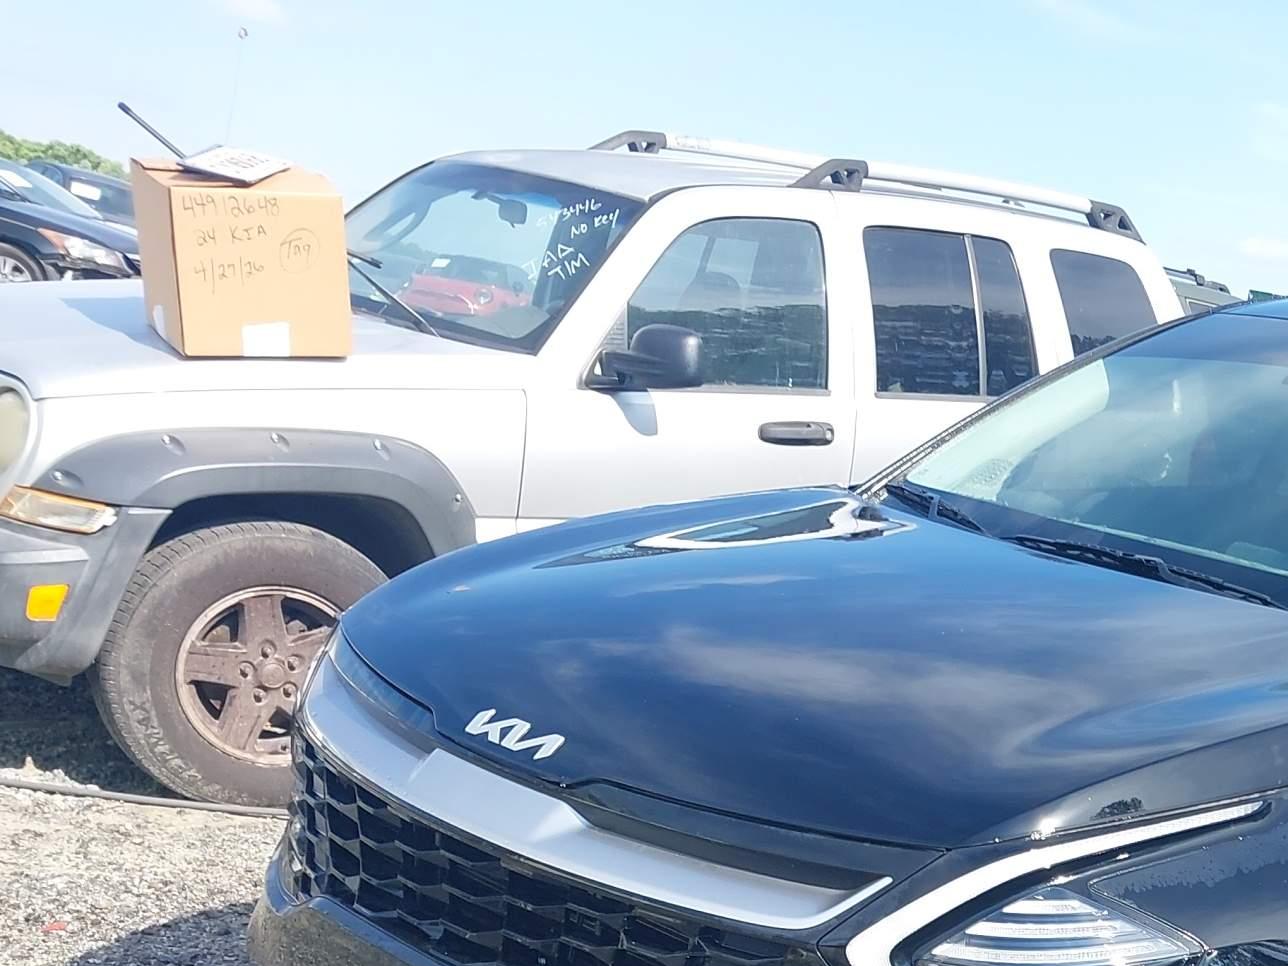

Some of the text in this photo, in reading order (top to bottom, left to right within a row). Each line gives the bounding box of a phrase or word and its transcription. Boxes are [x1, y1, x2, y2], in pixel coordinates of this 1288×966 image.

[182, 193, 280, 218] 44912648
[195, 224, 268, 247] 24 KIA
[570, 223, 588, 239] NO
[194, 255, 265, 295] 4/27/26
[547, 252, 591, 280] TIM
[464, 708, 566, 761] KIA
